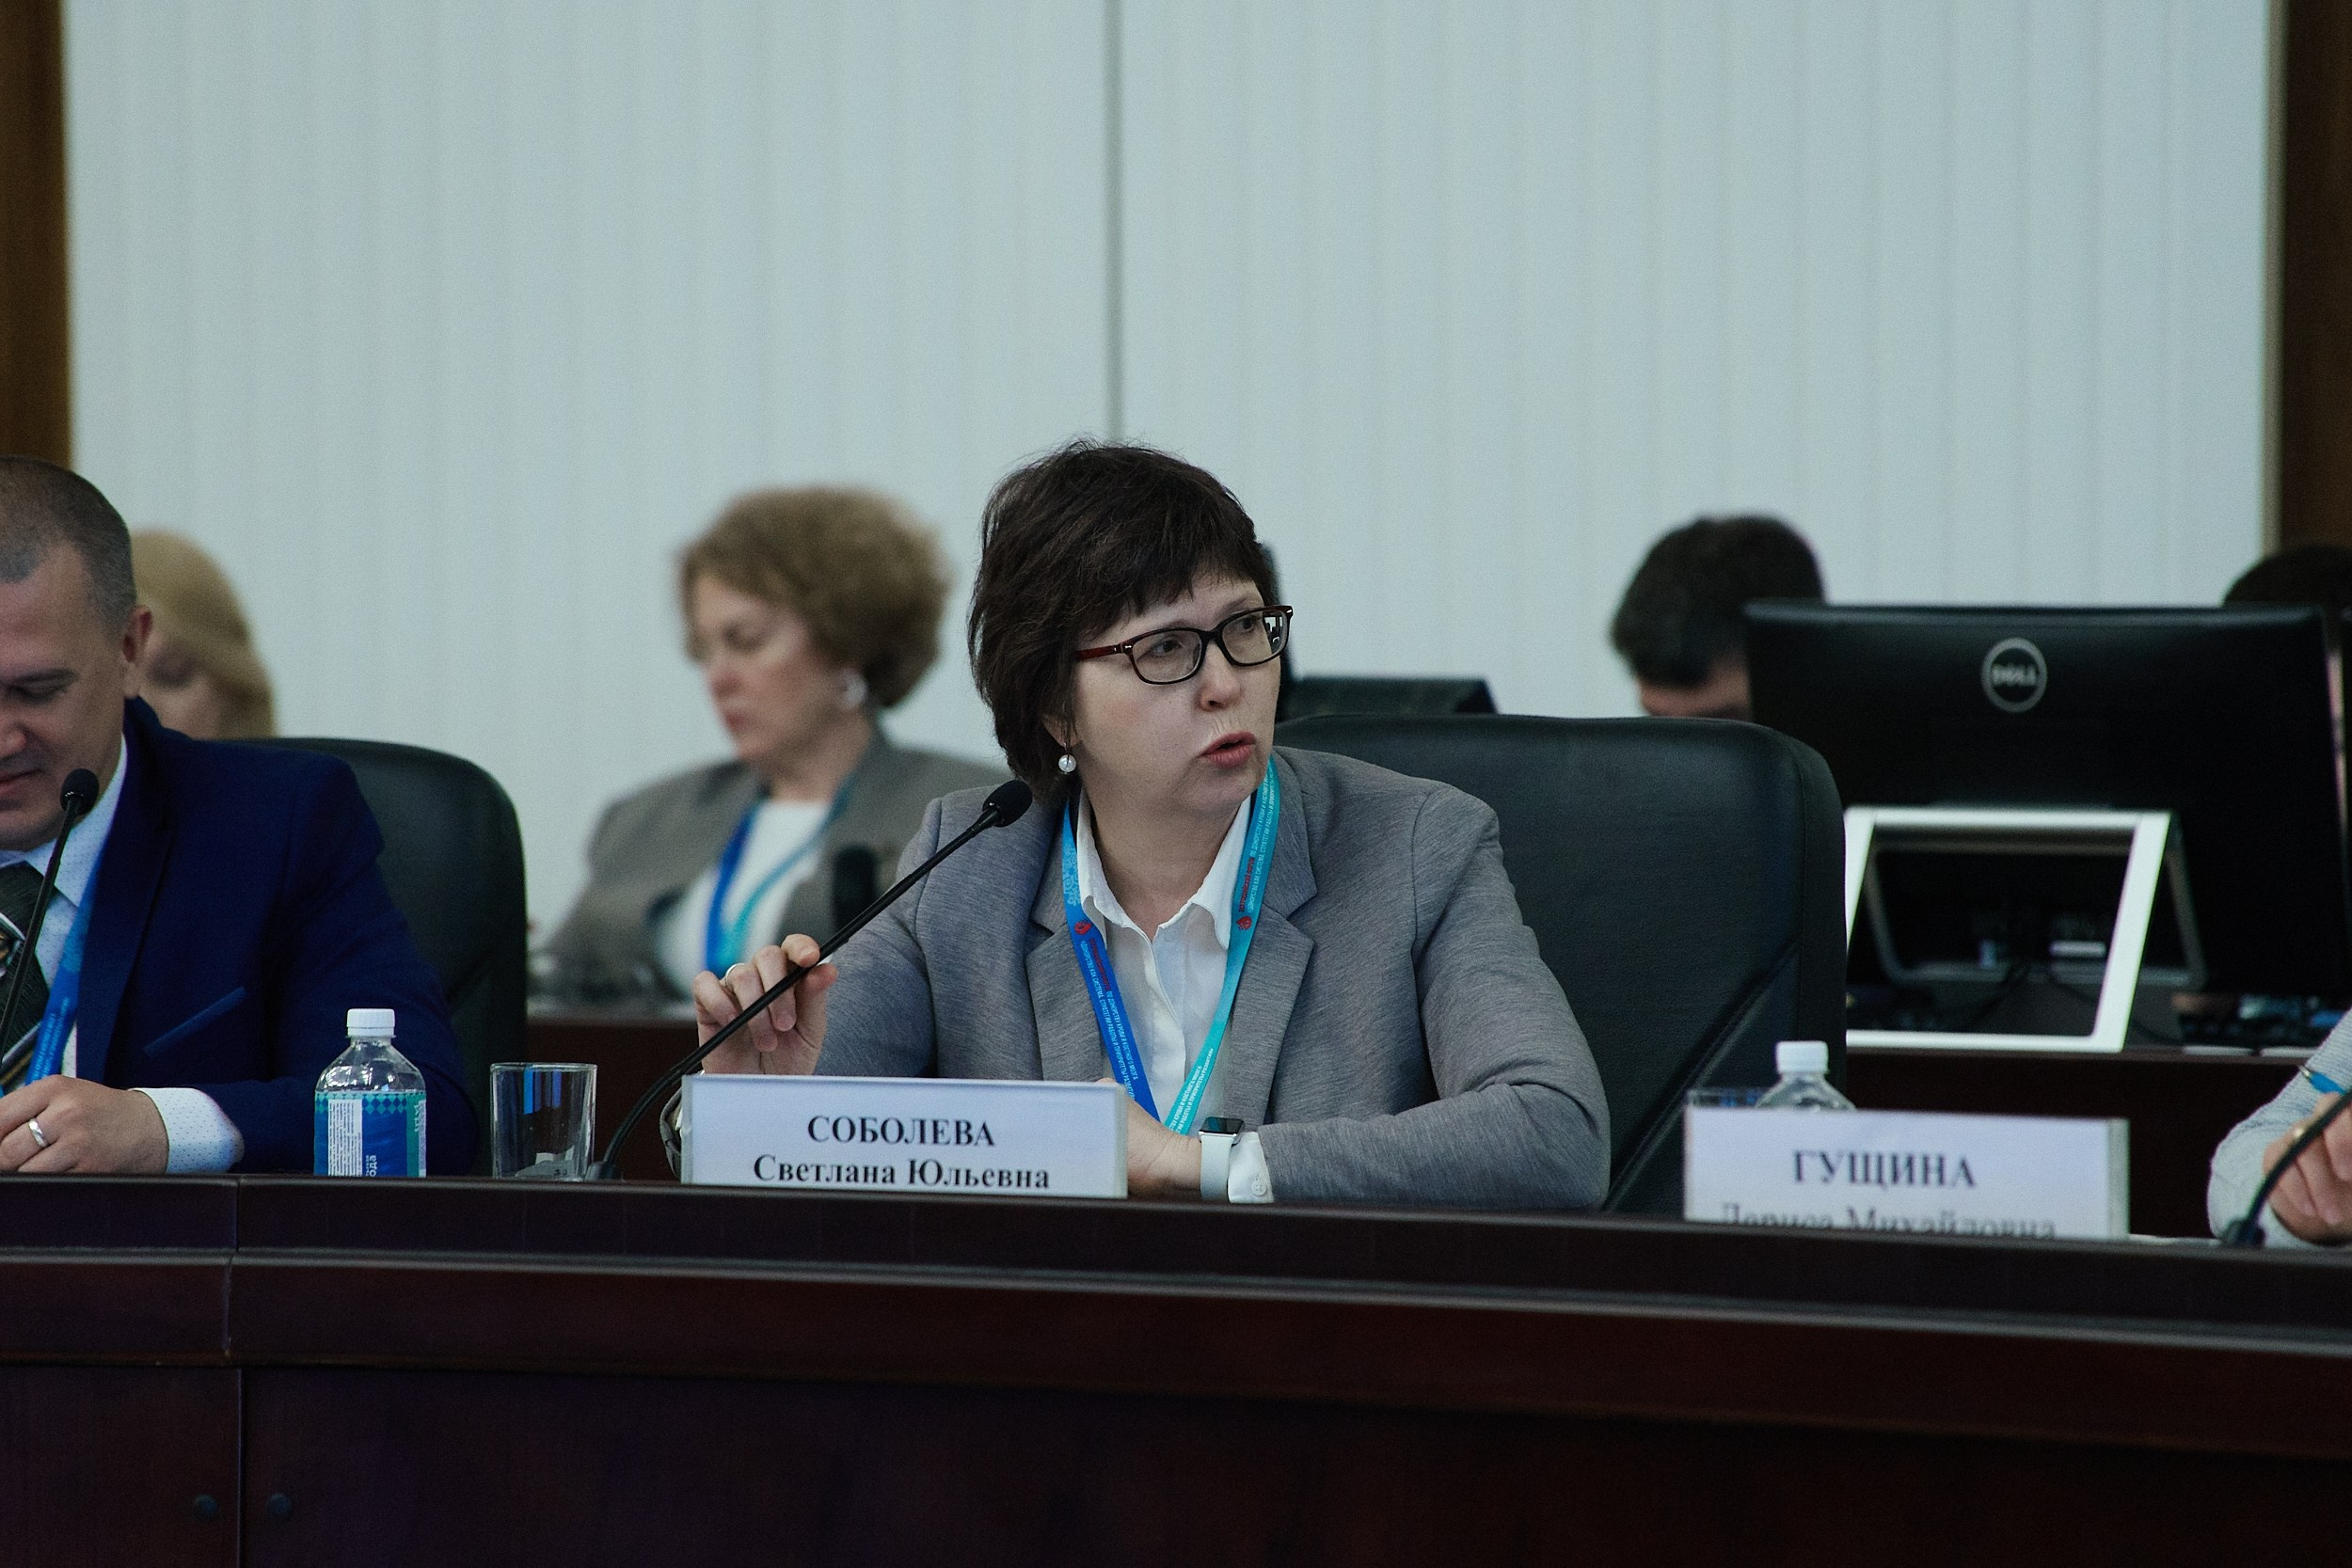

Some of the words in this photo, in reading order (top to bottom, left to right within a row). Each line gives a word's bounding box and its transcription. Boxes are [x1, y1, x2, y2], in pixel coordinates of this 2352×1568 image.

[1991, 662, 2037, 686] DELL
[807, 1115, 995, 1147] СОБОЛЕВА
[368, 1154, 377, 1178] ода
[753, 1153, 896, 1184] Светлана
[908, 1157, 1050, 1189] Юльевна
[1791, 1148, 1977, 1190] ГУЩИНА
